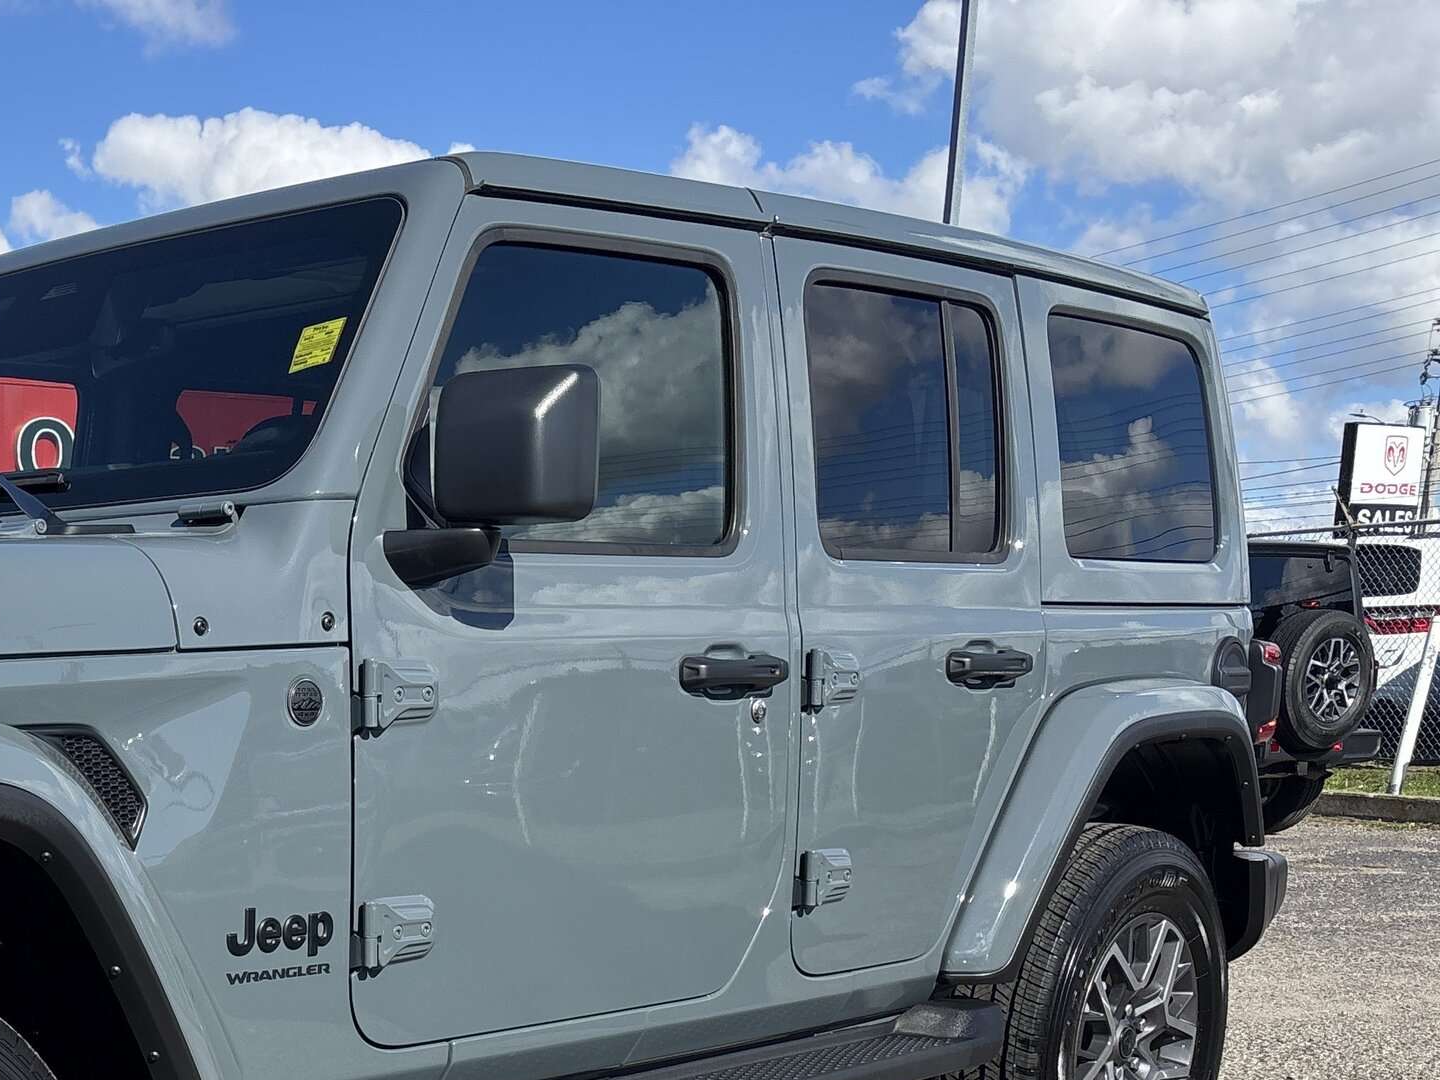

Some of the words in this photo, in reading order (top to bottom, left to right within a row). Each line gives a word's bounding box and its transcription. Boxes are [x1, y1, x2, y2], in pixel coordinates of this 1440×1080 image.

[1360, 483, 1417, 496] DODGE
[1357, 509, 1413, 533] SALES
[226, 907, 334, 957] Jeep
[226, 963, 331, 985] WRANGLER
